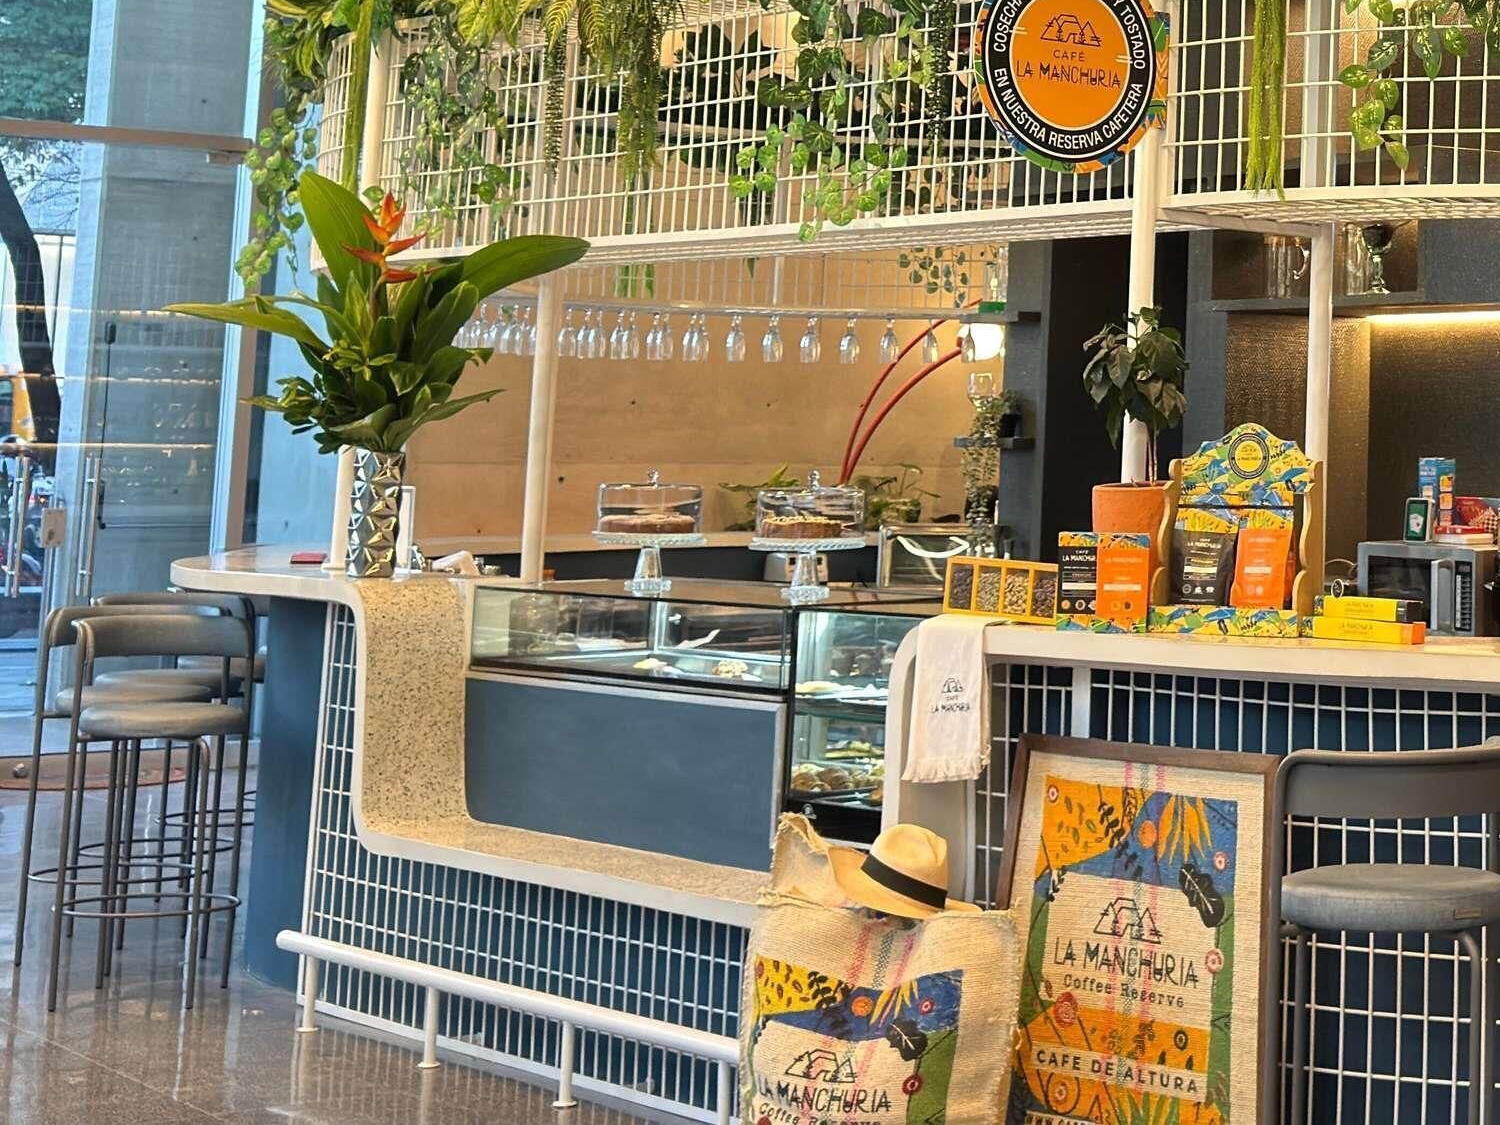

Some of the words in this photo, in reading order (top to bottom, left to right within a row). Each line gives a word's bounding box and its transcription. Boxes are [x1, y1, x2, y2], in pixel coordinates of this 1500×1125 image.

[1053, 49, 1086, 62] CAFÉ
[1120, 4, 1146, 69] TOSTADO
[1016, 61, 1034, 78] LA
[1040, 63, 1121, 89] MANCHURIA
[994, 68, 1007, 86] EN
[1001, 87, 1046, 143] NUESTRA
[1048, 132, 1103, 150] RESERVA
[1102, 83, 1143, 137] CAFETERA
[1054, 937, 1076, 967] LA
[1082, 941, 1199, 988] MANCHURIA
[1063, 974, 1112, 994] Coffee
[1120, 983, 1185, 1008] Reserve
[1036, 1050, 1081, 1071] CAFE
[1091, 1058, 1114, 1076] DE
[1123, 1066, 1198, 1093] ALTURA
[758, 1075, 774, 1100] LA
[776, 1080, 892, 1114] MANCHURIA
